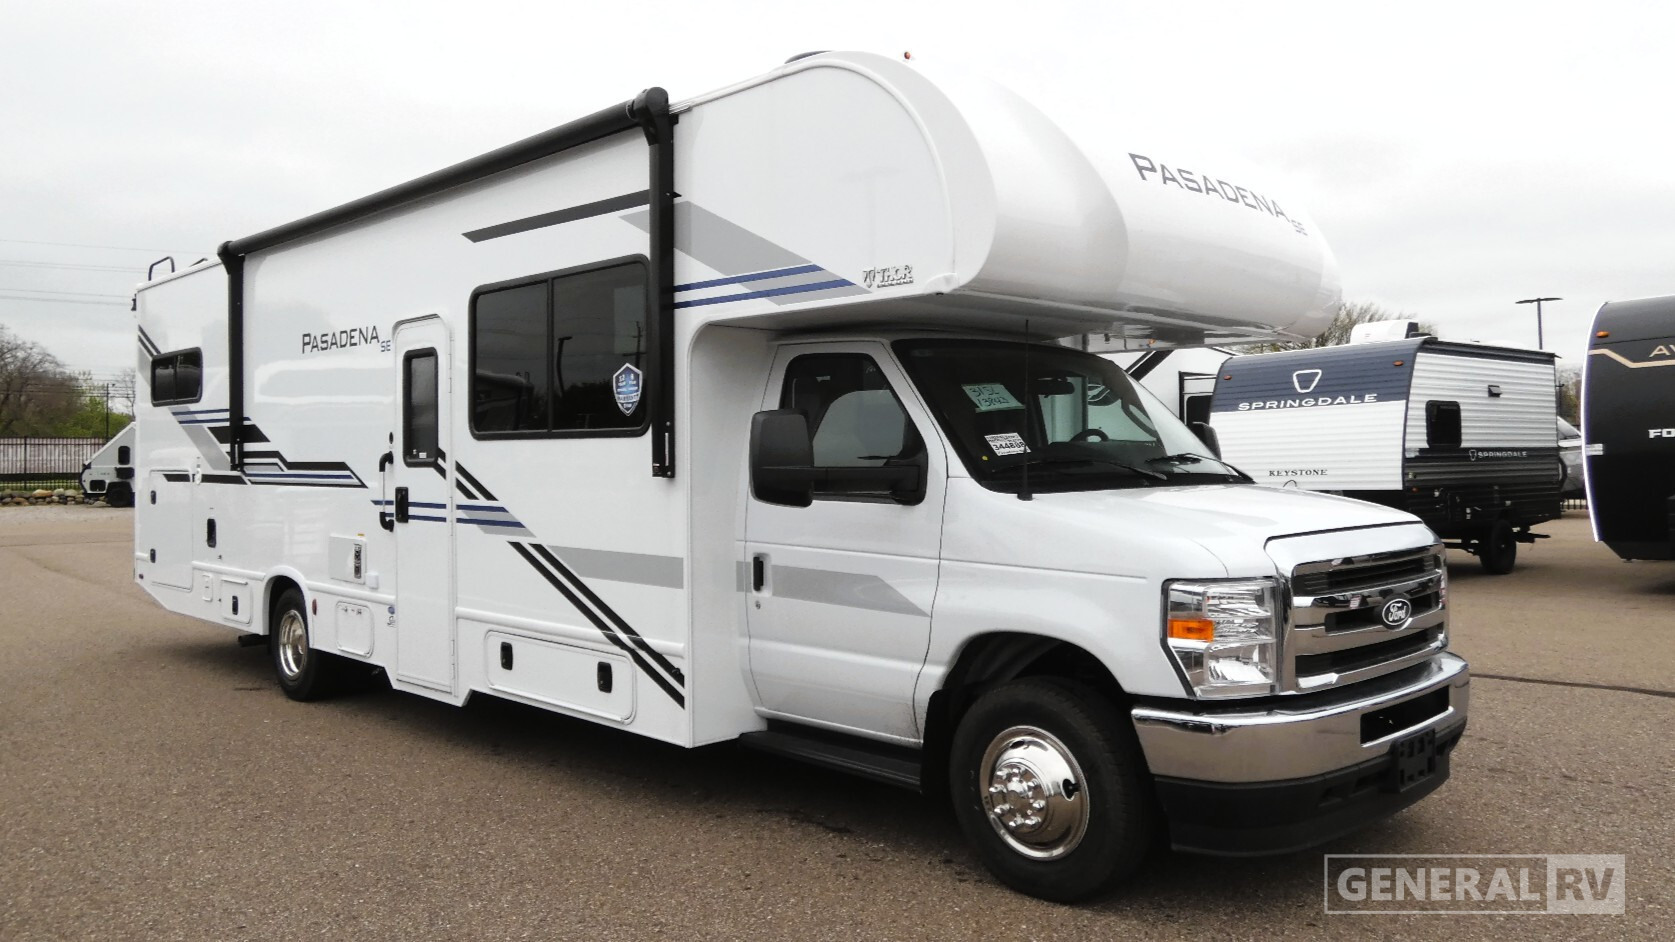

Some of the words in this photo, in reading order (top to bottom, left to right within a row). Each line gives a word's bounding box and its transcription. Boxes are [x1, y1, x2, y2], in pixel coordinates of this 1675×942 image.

[1128, 152, 1290, 223] PASADENA
[1290, 219, 1308, 236] SE
[302, 325, 380, 354] PASADENA
[380, 339, 391, 353] SE
[1238, 393, 1378, 411] SPRINGDALE
[1477, 451, 1528, 459] SPRINGDALE
[1268, 468, 1328, 477] KEYSTONE
[1388, 602, 1407, 621] Ford
